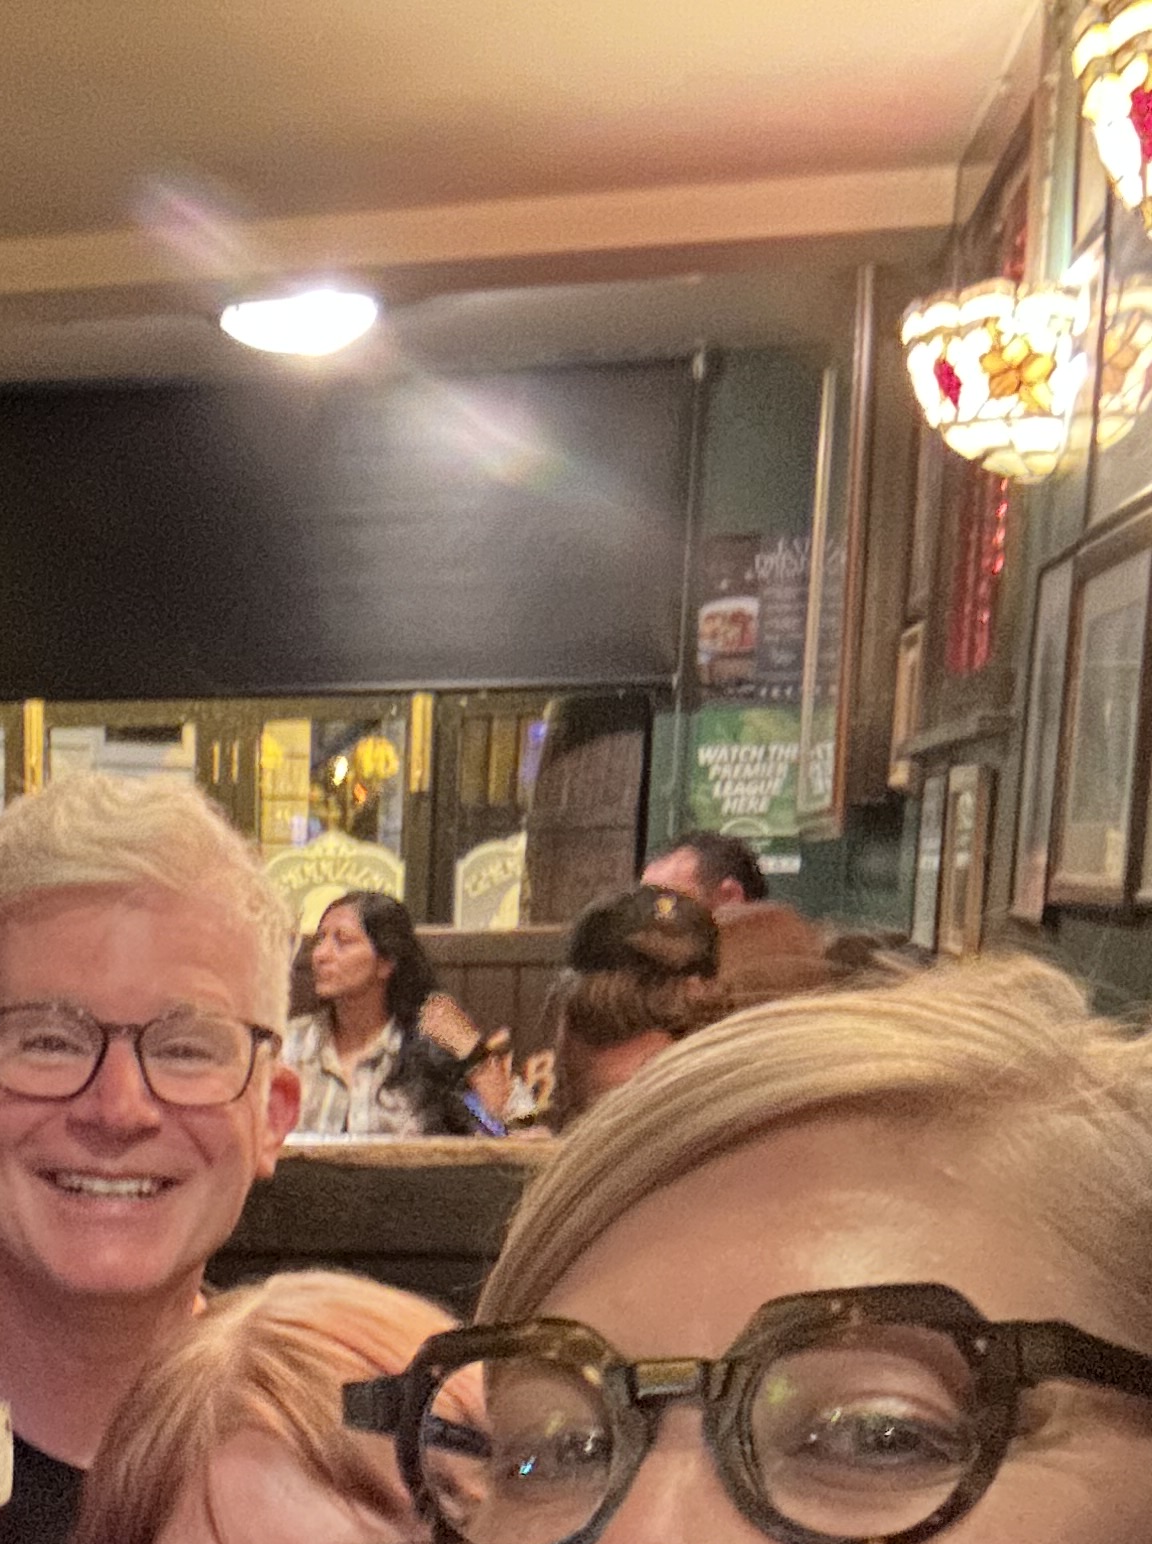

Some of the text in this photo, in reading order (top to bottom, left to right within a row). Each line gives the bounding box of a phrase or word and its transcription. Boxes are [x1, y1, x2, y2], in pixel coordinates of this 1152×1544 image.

[697, 743, 766, 767] WATCH
[708, 761, 790, 781] PREMIER
[712, 779, 785, 800] LEAGUE
[721, 796, 772, 816] HERE
